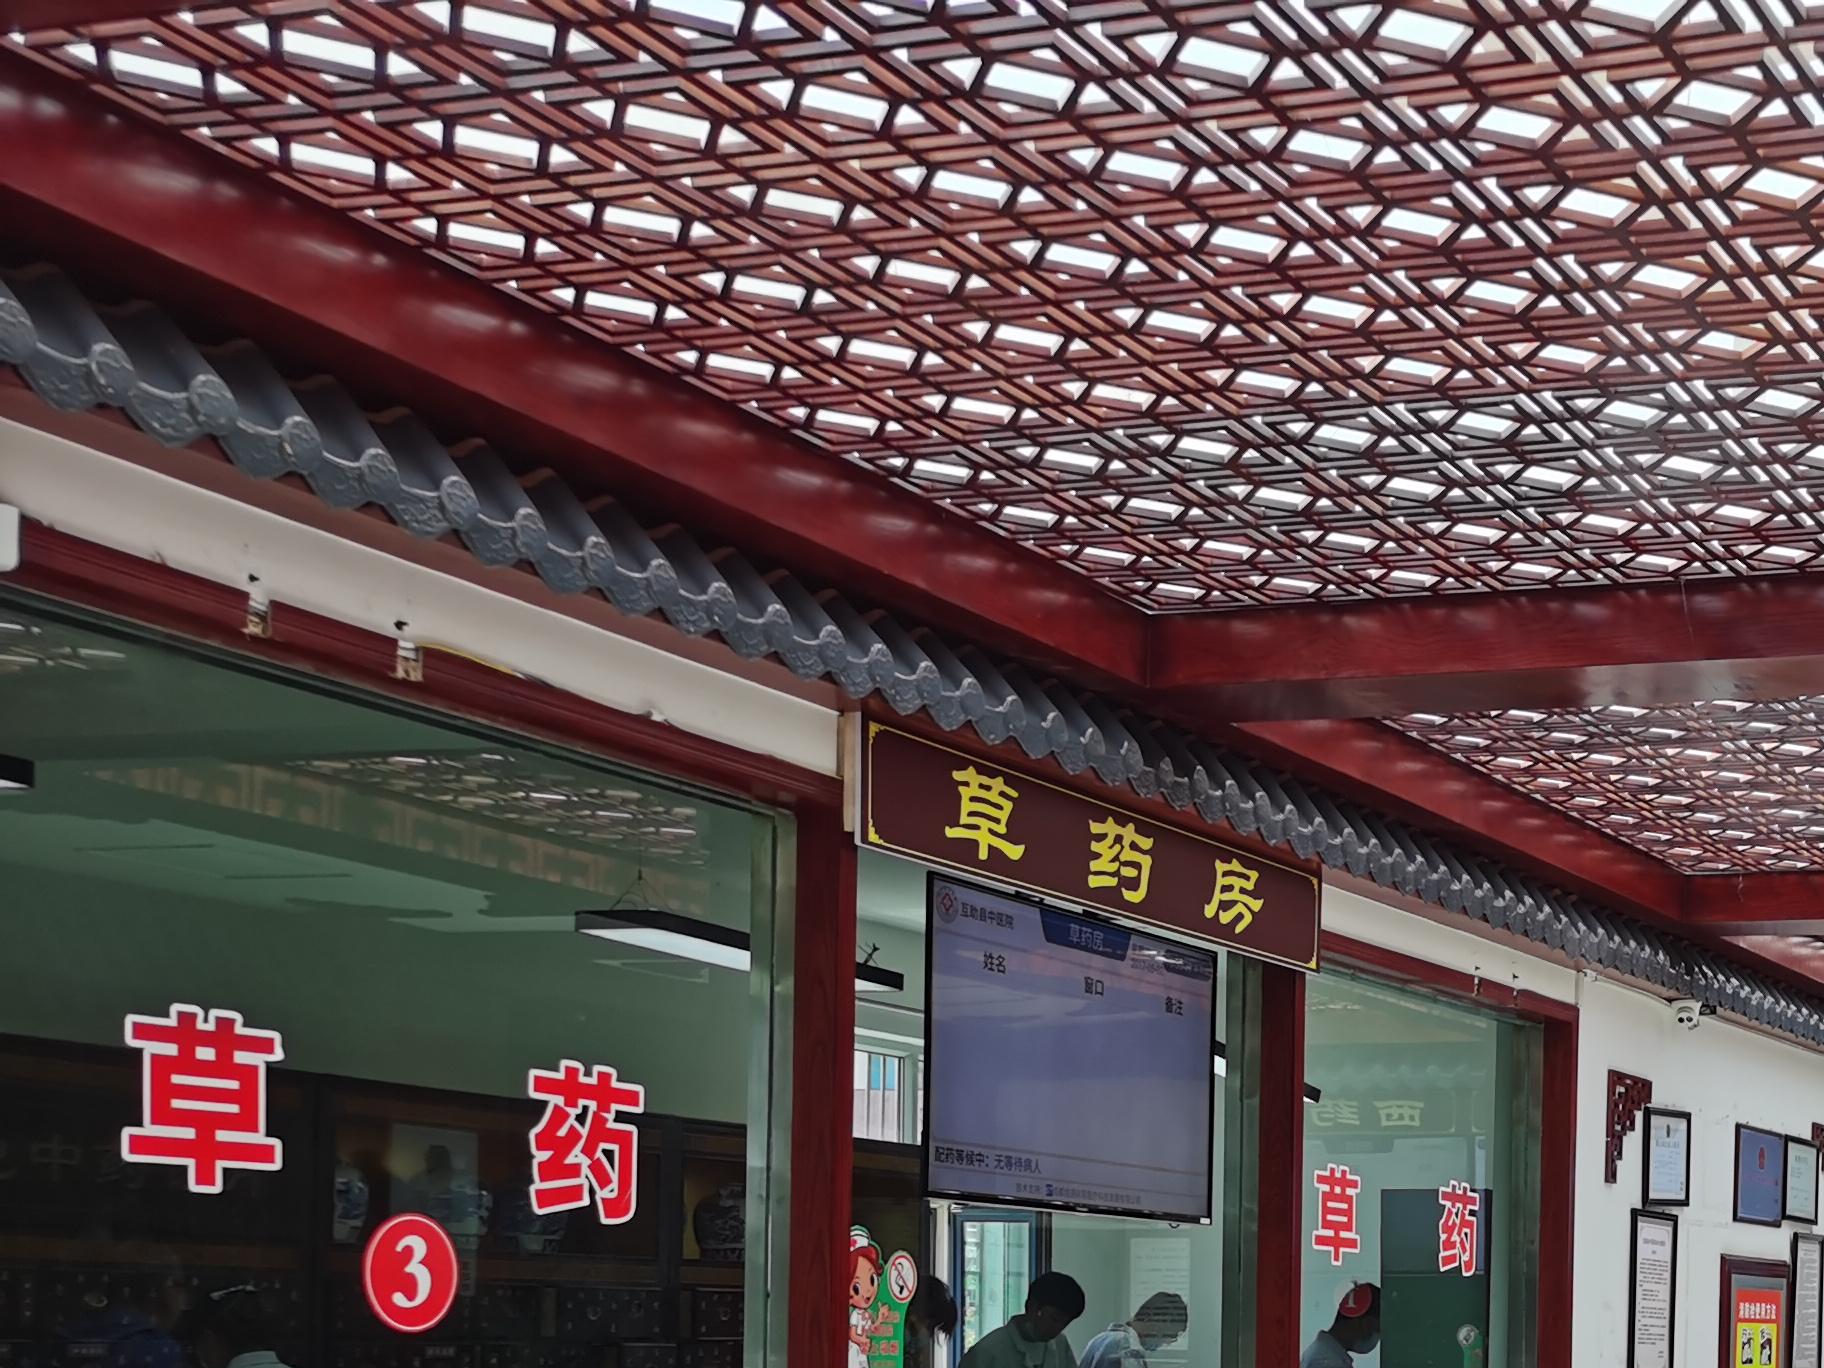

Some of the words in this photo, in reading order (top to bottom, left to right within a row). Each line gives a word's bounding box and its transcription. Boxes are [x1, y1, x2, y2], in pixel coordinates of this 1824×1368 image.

[944, 766, 1264, 933] 草药房
[960, 902, 1015, 930] 互助县中医院
[1068, 923, 1104, 950] 草药房
[982, 951, 1006, 975] 姓名
[1084, 976, 1105, 996] 窗口
[1164, 996, 1184, 1016] 备注
[121, 1003, 285, 1194] 草
[528, 1059, 645, 1226] 药
[1312, 1162, 1362, 1267] 草
[1439, 1180, 1480, 1278] 药
[391, 1234, 434, 1309] 3
